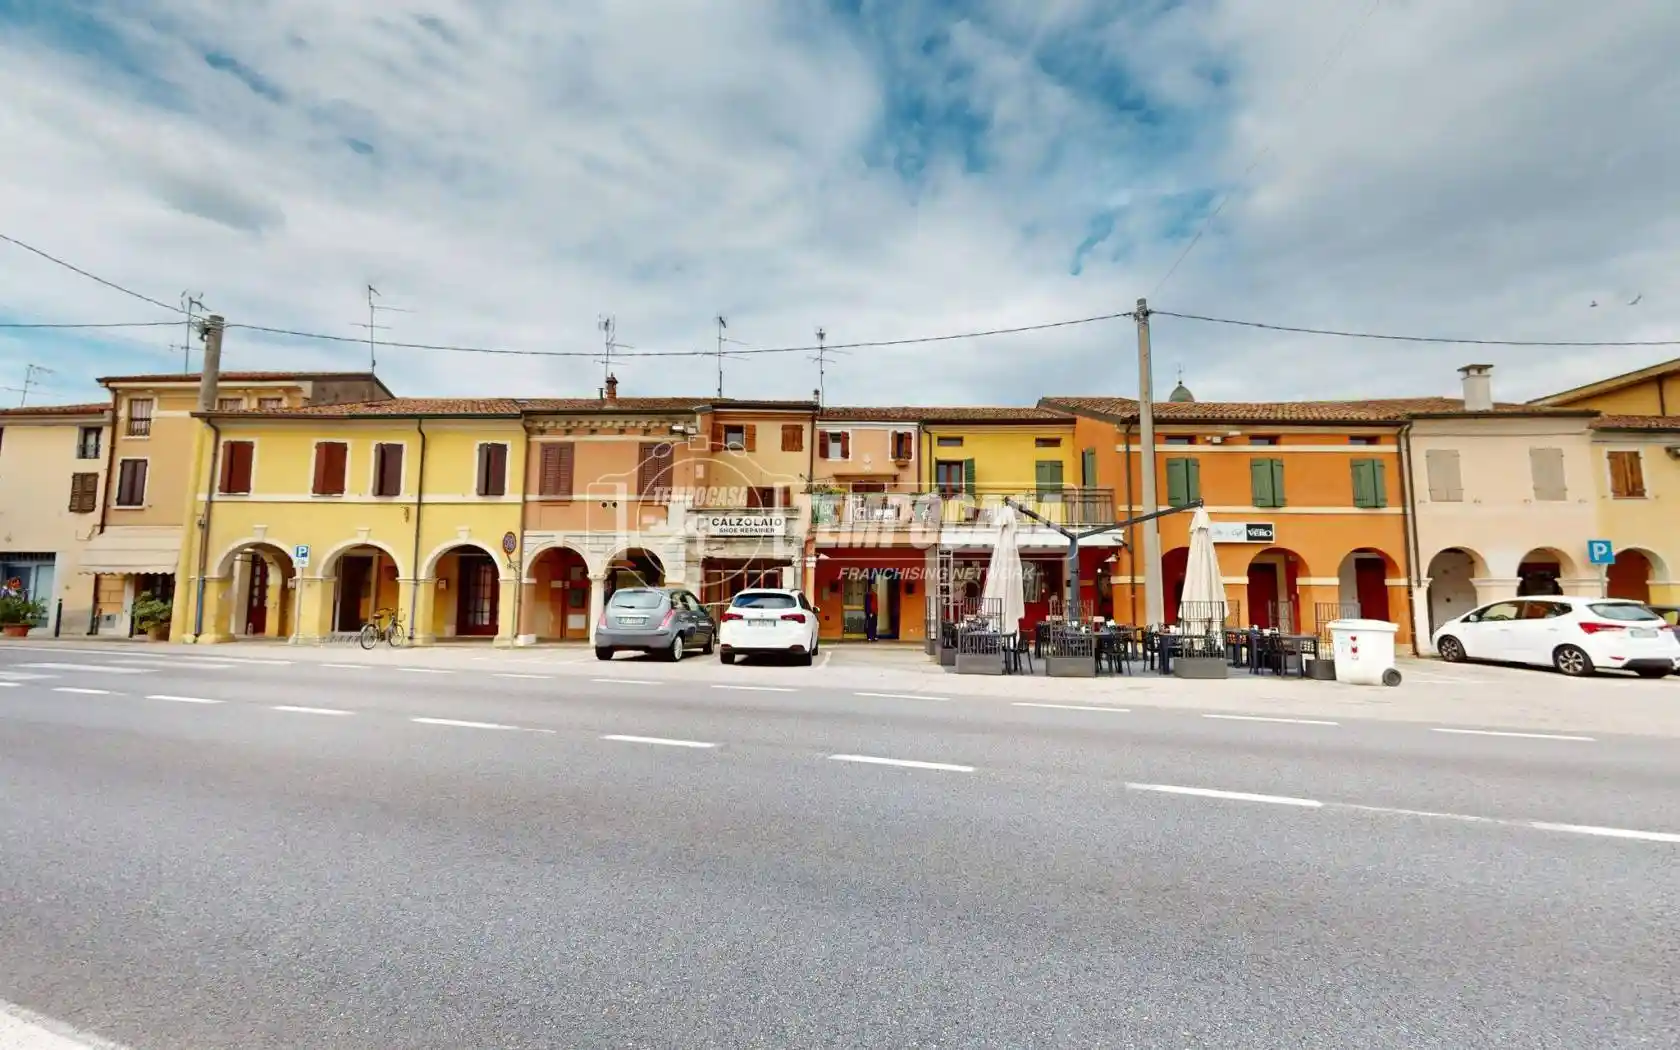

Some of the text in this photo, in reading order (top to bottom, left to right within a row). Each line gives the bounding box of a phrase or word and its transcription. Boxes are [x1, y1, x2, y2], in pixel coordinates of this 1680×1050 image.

[711, 517, 782, 526] CALZOLAIO
[297, 546, 307, 557] P
[1592, 542, 1607, 561] P
